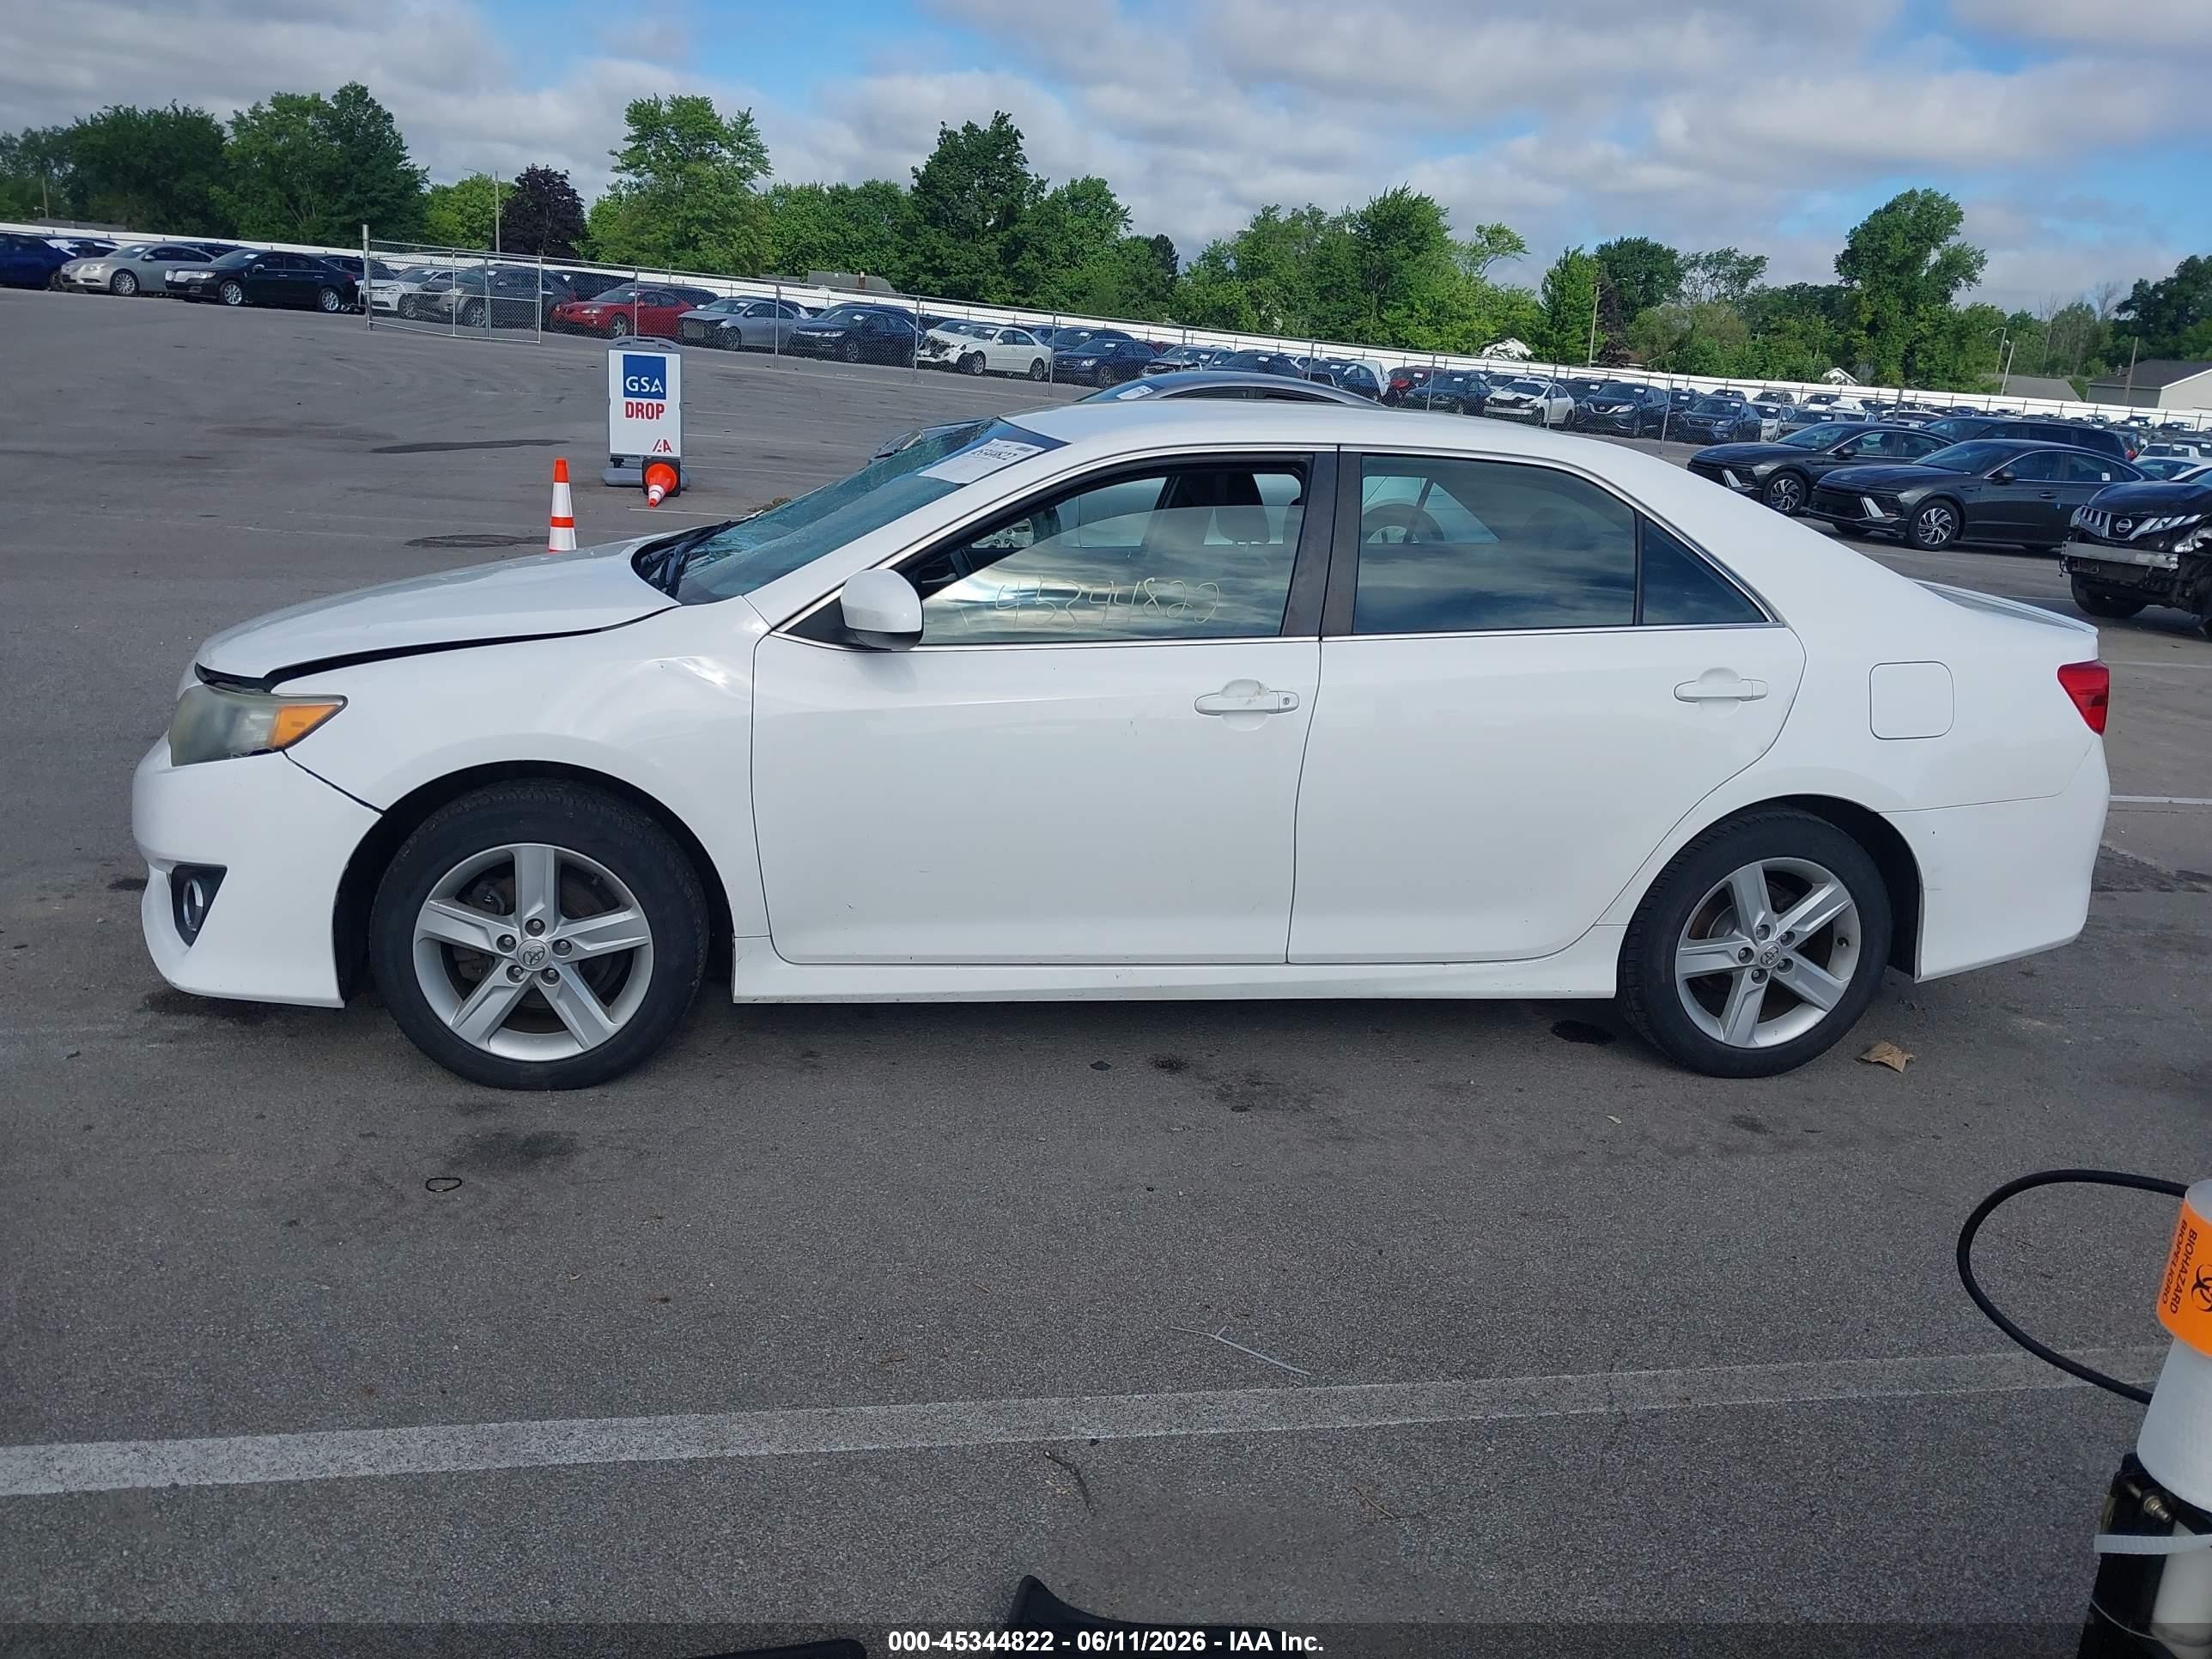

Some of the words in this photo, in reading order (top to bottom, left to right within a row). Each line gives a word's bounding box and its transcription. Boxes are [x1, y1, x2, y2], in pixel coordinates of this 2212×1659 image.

[625, 376, 664, 393] GSA
[625, 401, 665, 420] DROP
[995, 576, 1219, 632] 45344822
[2170, 1228, 2197, 1314] BIOHAZARD
